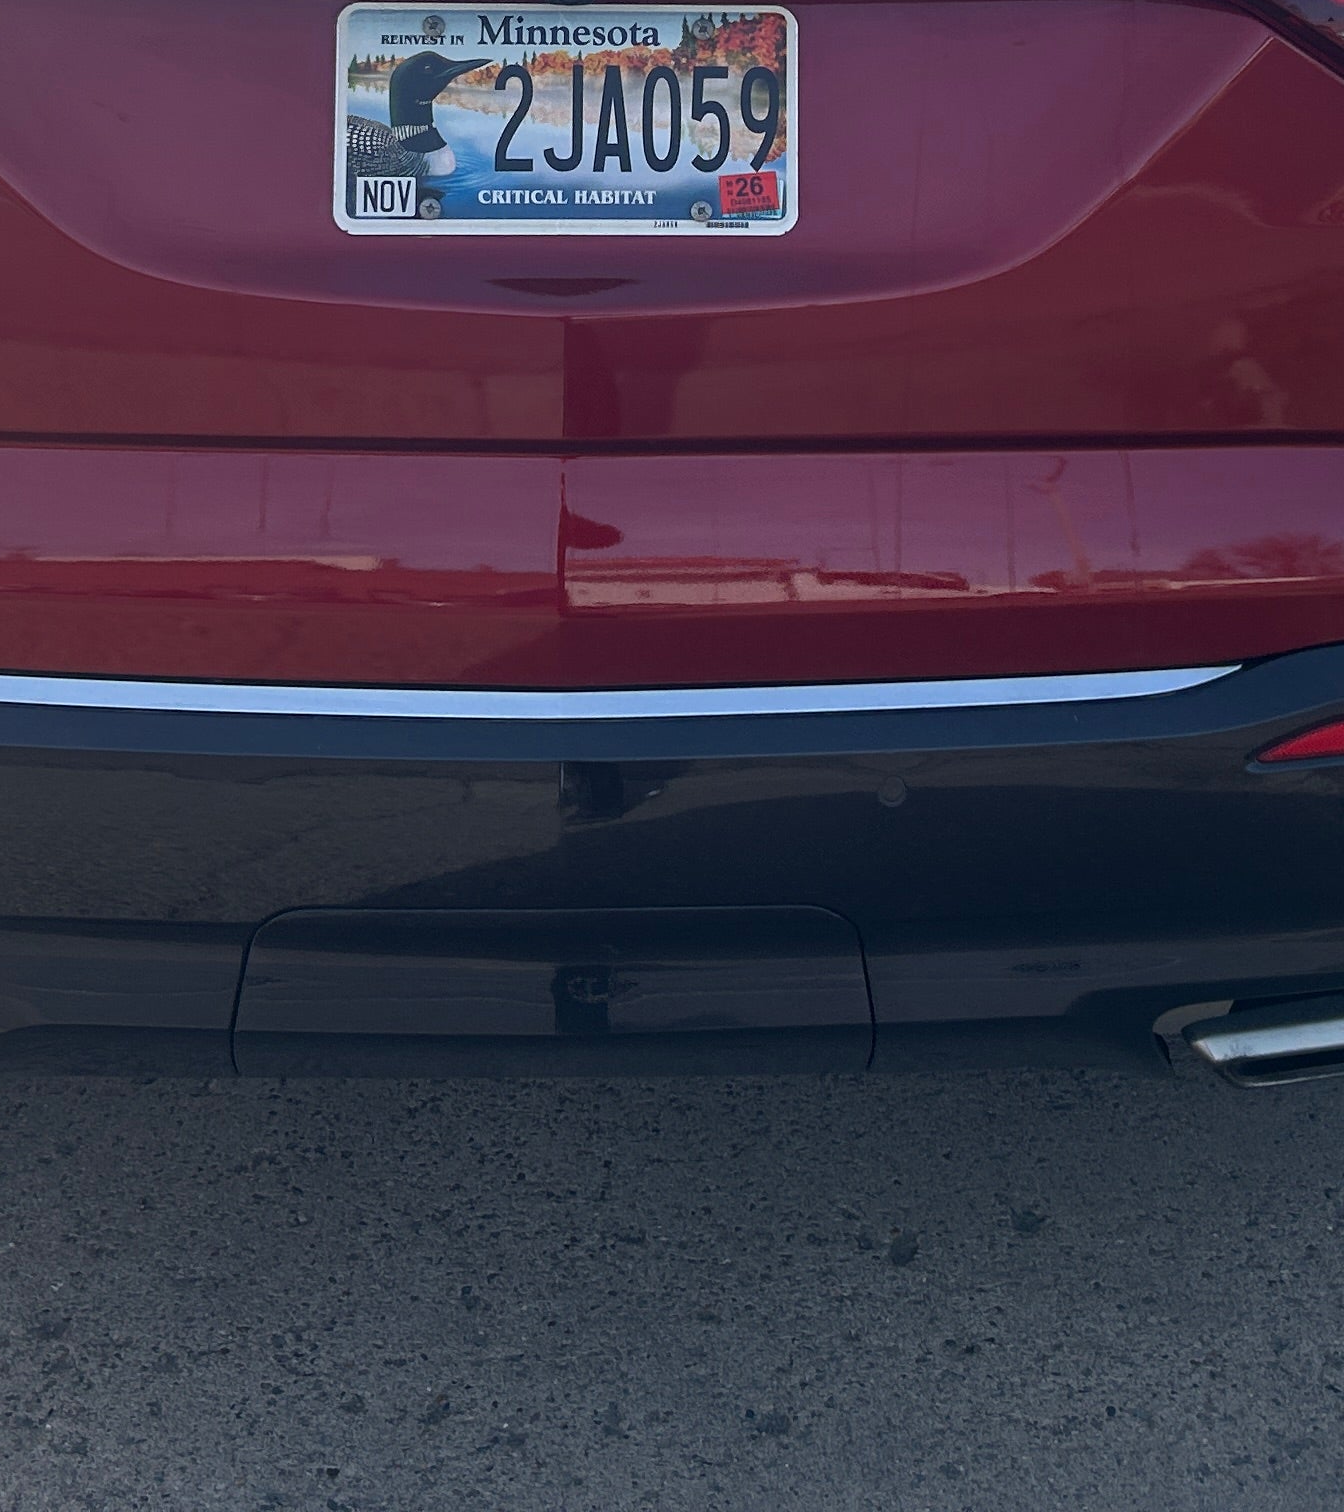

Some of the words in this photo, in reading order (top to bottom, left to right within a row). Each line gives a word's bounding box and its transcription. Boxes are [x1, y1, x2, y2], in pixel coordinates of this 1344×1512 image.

[381, 34, 446, 46] REINVEST
[451, 34, 465, 46] IN
[477, 15, 661, 48] Minnesota
[494, 64, 781, 173] 2JA059
[362, 180, 412, 213] NOV
[477, 189, 568, 205] CRITICAL
[574, 190, 657, 205] HABITAT
[736, 176, 764, 197] 26
